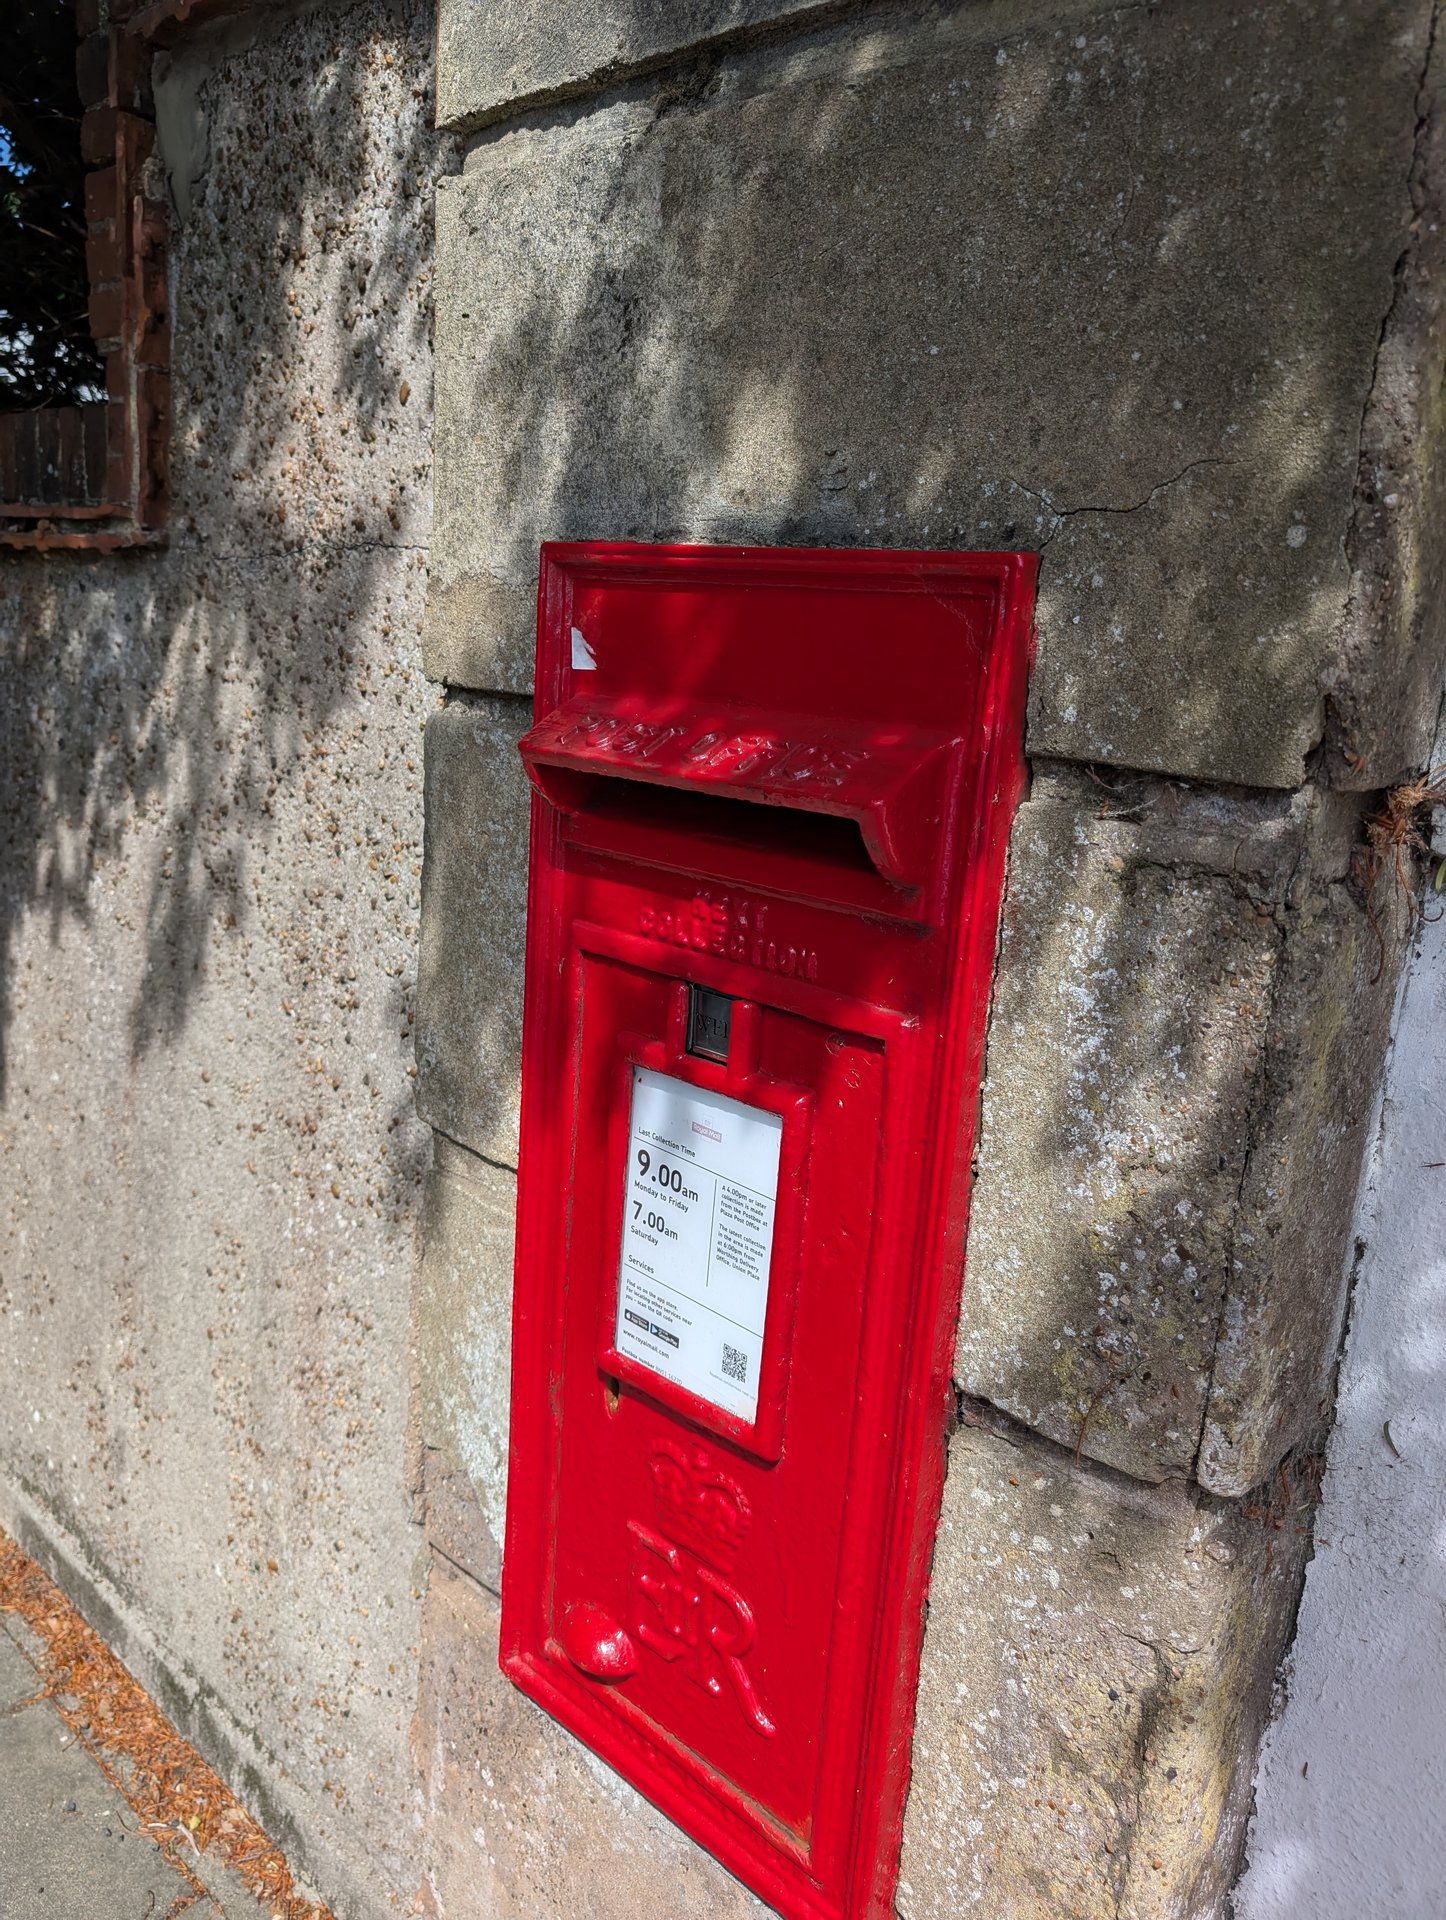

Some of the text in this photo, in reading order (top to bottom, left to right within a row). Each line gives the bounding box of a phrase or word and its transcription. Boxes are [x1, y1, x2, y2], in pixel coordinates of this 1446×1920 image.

[559, 715, 871, 786] POST OFFICE
[691, 891, 769, 932] NEXT
[639, 905, 818, 979] COLLECTION
[639, 1126, 696, 1157] Last Collection Time
[637, 1149, 699, 1202] 9.00am
[634, 1180, 689, 1213] Monday to Friday
[721, 1193, 744, 1207] collection
[750, 1207, 764, 1217] made
[727, 1187, 748, 1200] 4.00pm
[755, 1200, 767, 1209] later
[633, 1200, 678, 1240] 7.00am
[720, 1208, 760, 1231] Plaza Post Office
[721, 1200, 733, 1210] from
[733, 1206, 741, 1214] the
[742, 1211, 761, 1224] Postbox
[630, 1225, 659, 1246] Saturday
[719, 1223, 767, 1251] The latest collection
[724, 1233, 732, 1242] the
[733, 1240, 744, 1248] area
[750, 1247, 764, 1258] made
[628, 1254, 655, 1274] Services
[717, 1246, 759, 1273] Worthing Delivery
[743, 1252, 756, 1262] from
[732, 1262, 746, 1274] Union
[747, 1270, 760, 1280] Place
[626, 1278, 636, 1288] Find
[657, 1294, 665, 1304] app
[625, 1294, 634, 1302] you
[637, 1300, 647, 1309] scan
[663, 1314, 673, 1323] code
[634, 1289, 651, 1304] locating
[651, 1299, 663, 1310] other
[664, 1304, 681, 1320] services
[682, 1317, 692, 1326] near
[621, 1346, 638, 1359] Postbox
[638, 1357, 655, 1369] number
[623, 1329, 669, 1359] www.royalmail.com
